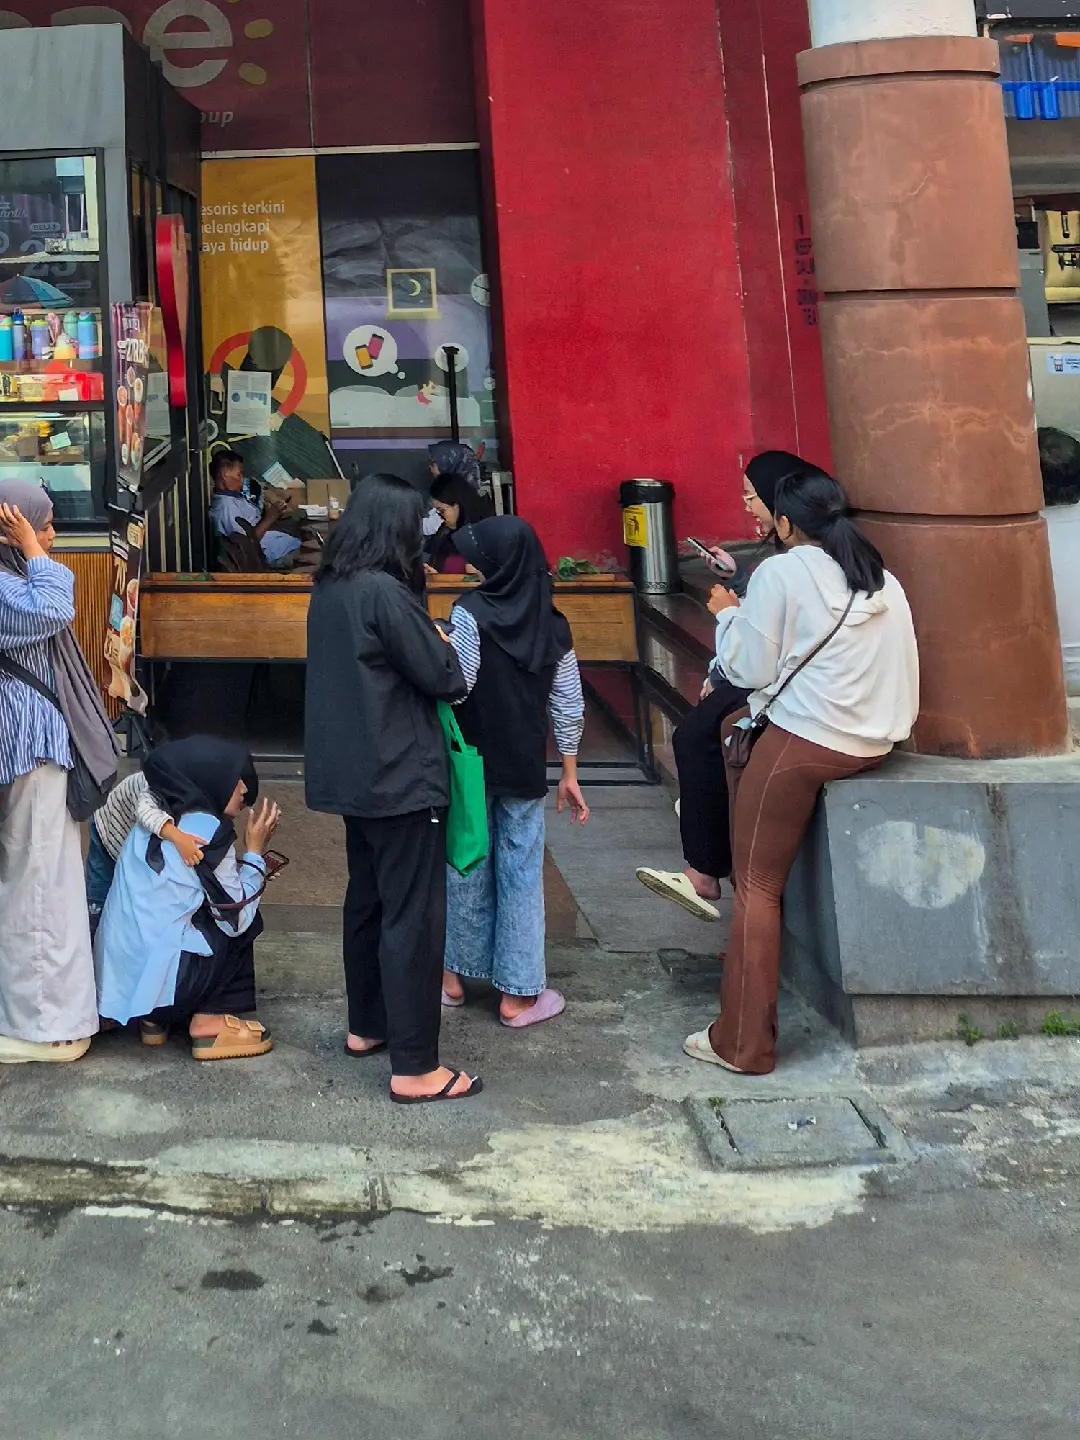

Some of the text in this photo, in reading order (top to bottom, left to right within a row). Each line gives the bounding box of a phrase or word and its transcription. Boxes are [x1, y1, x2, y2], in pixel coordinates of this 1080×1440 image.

[242, 200, 285, 215] terkini
[201, 237, 270, 256] aya hidup
